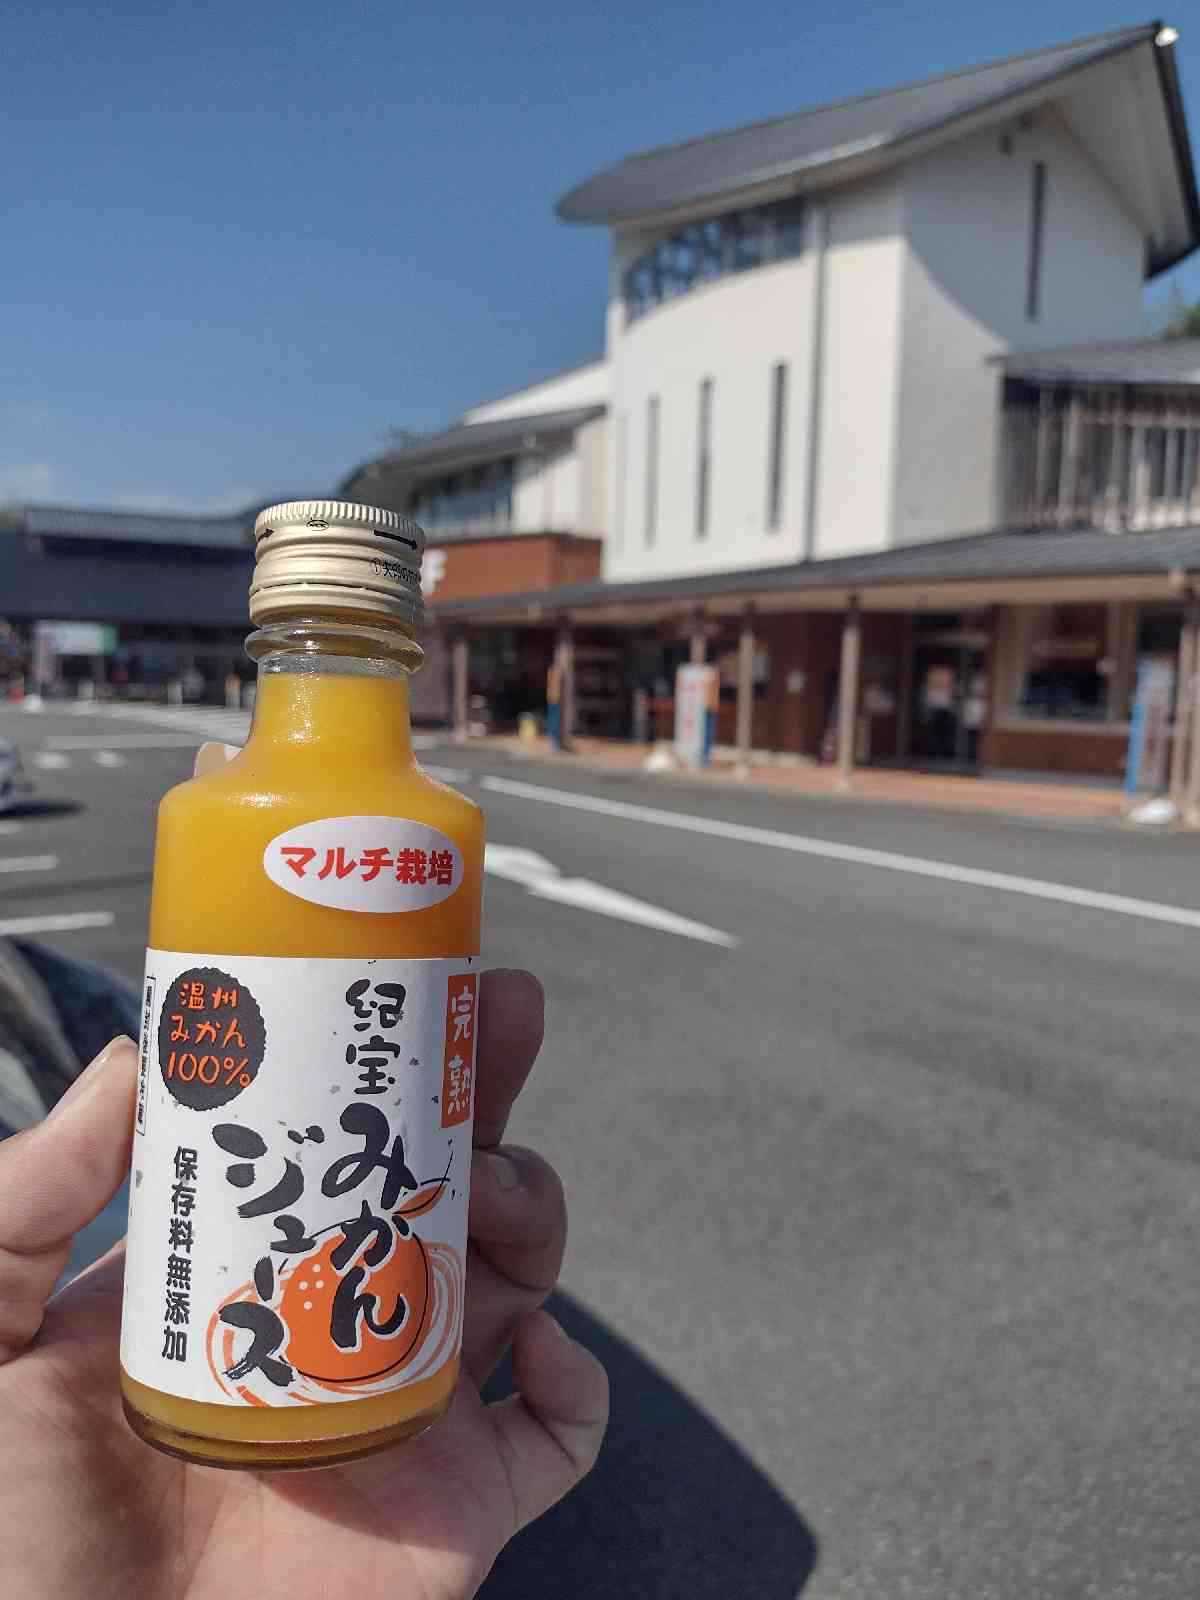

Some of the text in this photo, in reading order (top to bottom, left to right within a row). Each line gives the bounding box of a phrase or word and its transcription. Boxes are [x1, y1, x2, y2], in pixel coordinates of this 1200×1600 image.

[280, 847, 454, 886] マルチ栽培
[178, 981, 239, 1010] 温州
[170, 1014, 247, 1049] みかん
[447, 984, 474, 1115] 完熟
[166, 1051, 251, 1088] 100%
[161, 1145, 198, 1363] 保存料無添加
[211, 1122, 326, 1387] ジュース
